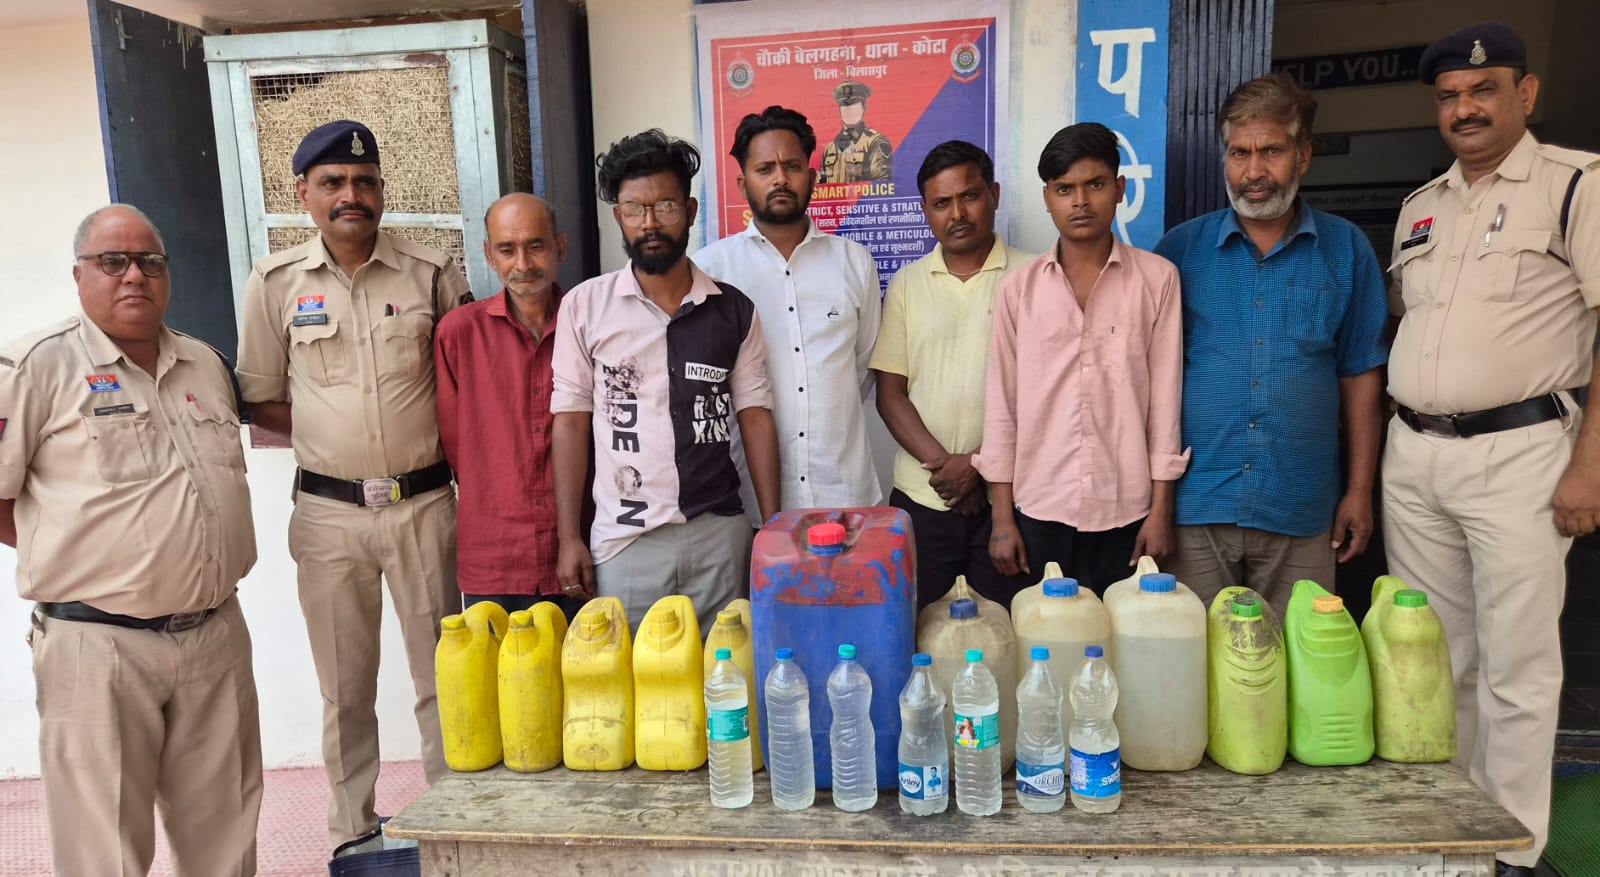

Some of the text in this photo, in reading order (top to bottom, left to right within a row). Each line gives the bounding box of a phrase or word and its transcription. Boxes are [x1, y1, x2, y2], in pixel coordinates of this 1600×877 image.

[756, 47, 791, 67] चौकी
[865, 42, 899, 59] थाना
[911, 36, 948, 55] कोटा
[814, 66, 838, 80] जिला
[811, 183, 895, 199] SMART POLICE
[836, 203, 880, 215] SENSITIVE
[882, 203, 889, 213] &
[876, 231, 883, 240] &
